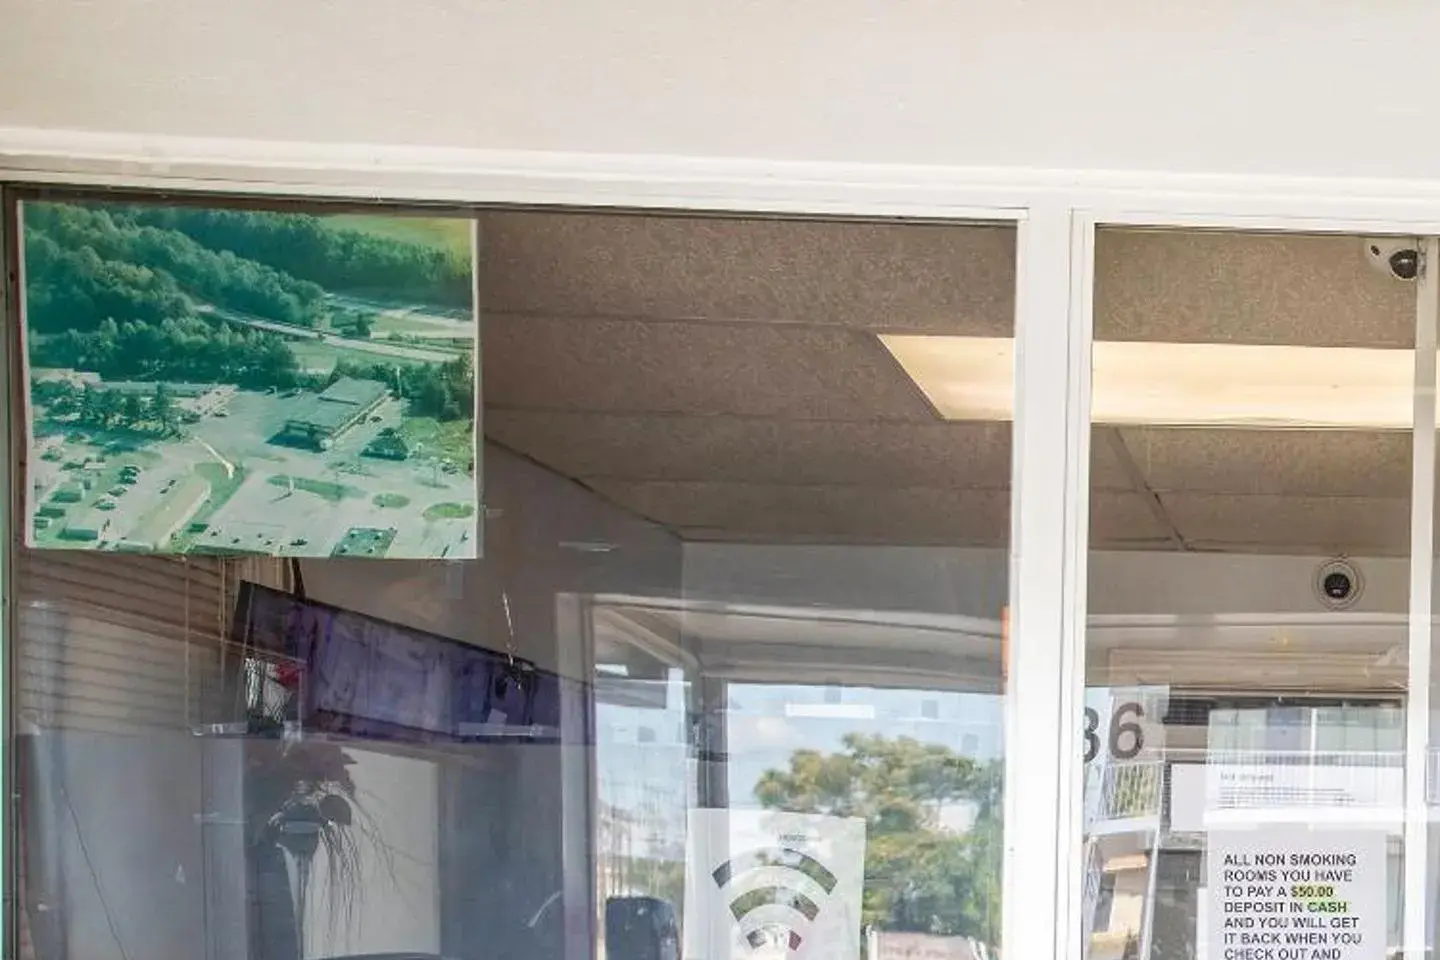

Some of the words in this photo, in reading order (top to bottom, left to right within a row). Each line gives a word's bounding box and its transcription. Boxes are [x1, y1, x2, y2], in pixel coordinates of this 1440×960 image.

[1224, 854, 1251, 866] ALL
[1255, 854, 1285, 866] NON
[1290, 854, 1356, 866] SMOKING
[1225, 870, 1277, 882] ROOMS
[1280, 870, 1310, 882] YOU
[1315, 870, 1352, 882] HAVE
[1224, 886, 1243, 897] TO
[1248, 886, 1273, 897] PAY
[1277, 886, 1287, 897] A
[1291, 886, 1333, 897] $50.00
[1225, 902, 1285, 912] DEPOSIT
[1290, 902, 1303, 912] IN
[1307, 902, 1346, 912] CASH
[1225, 917, 1254, 928] AND
[1259, 917, 1288, 928] YOU
[1292, 918, 1326, 928] WILL
[1330, 917, 1359, 928] GET
[1225, 933, 1237, 944] IT
[1241, 933, 1281, 945] BACK
[1285, 933, 1327, 944] WHEN
[1332, 933, 1361, 945] YOU
[1225, 948, 1273, 960] CHECK
[1278, 948, 1308, 960] OUT
[1311, 948, 1340, 960] AND
